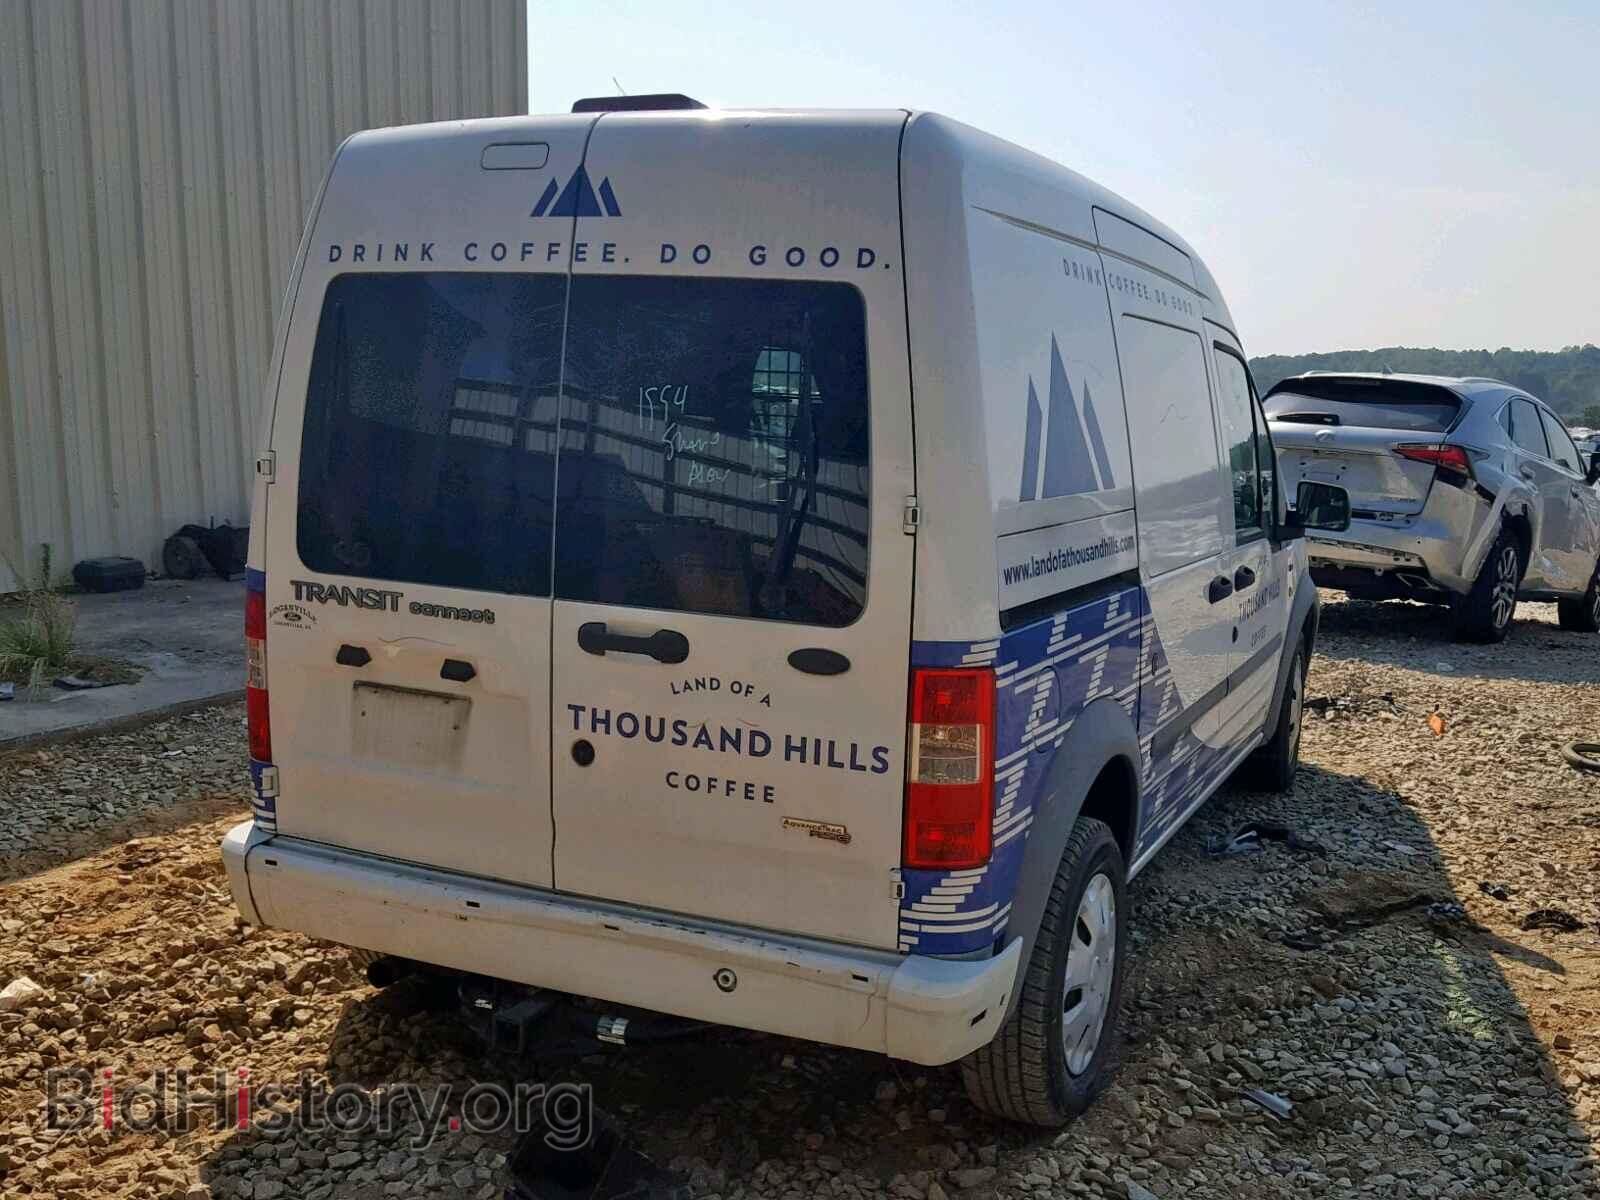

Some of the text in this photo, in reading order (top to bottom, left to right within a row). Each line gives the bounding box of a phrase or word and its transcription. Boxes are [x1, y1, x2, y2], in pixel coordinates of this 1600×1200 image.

[329, 242, 891, 269] DRINK COFFEE. DO GOOD.
[1063, 257, 1102, 287] DRINK
[1003, 535, 1135, 586] www.landofathousandhills.com
[290, 580, 496, 624] TRANSIT connect
[670, 677, 771, 707] LAND OF A
[567, 703, 889, 774] THOUSAND HILLS
[665, 771, 775, 803] COFFEE
